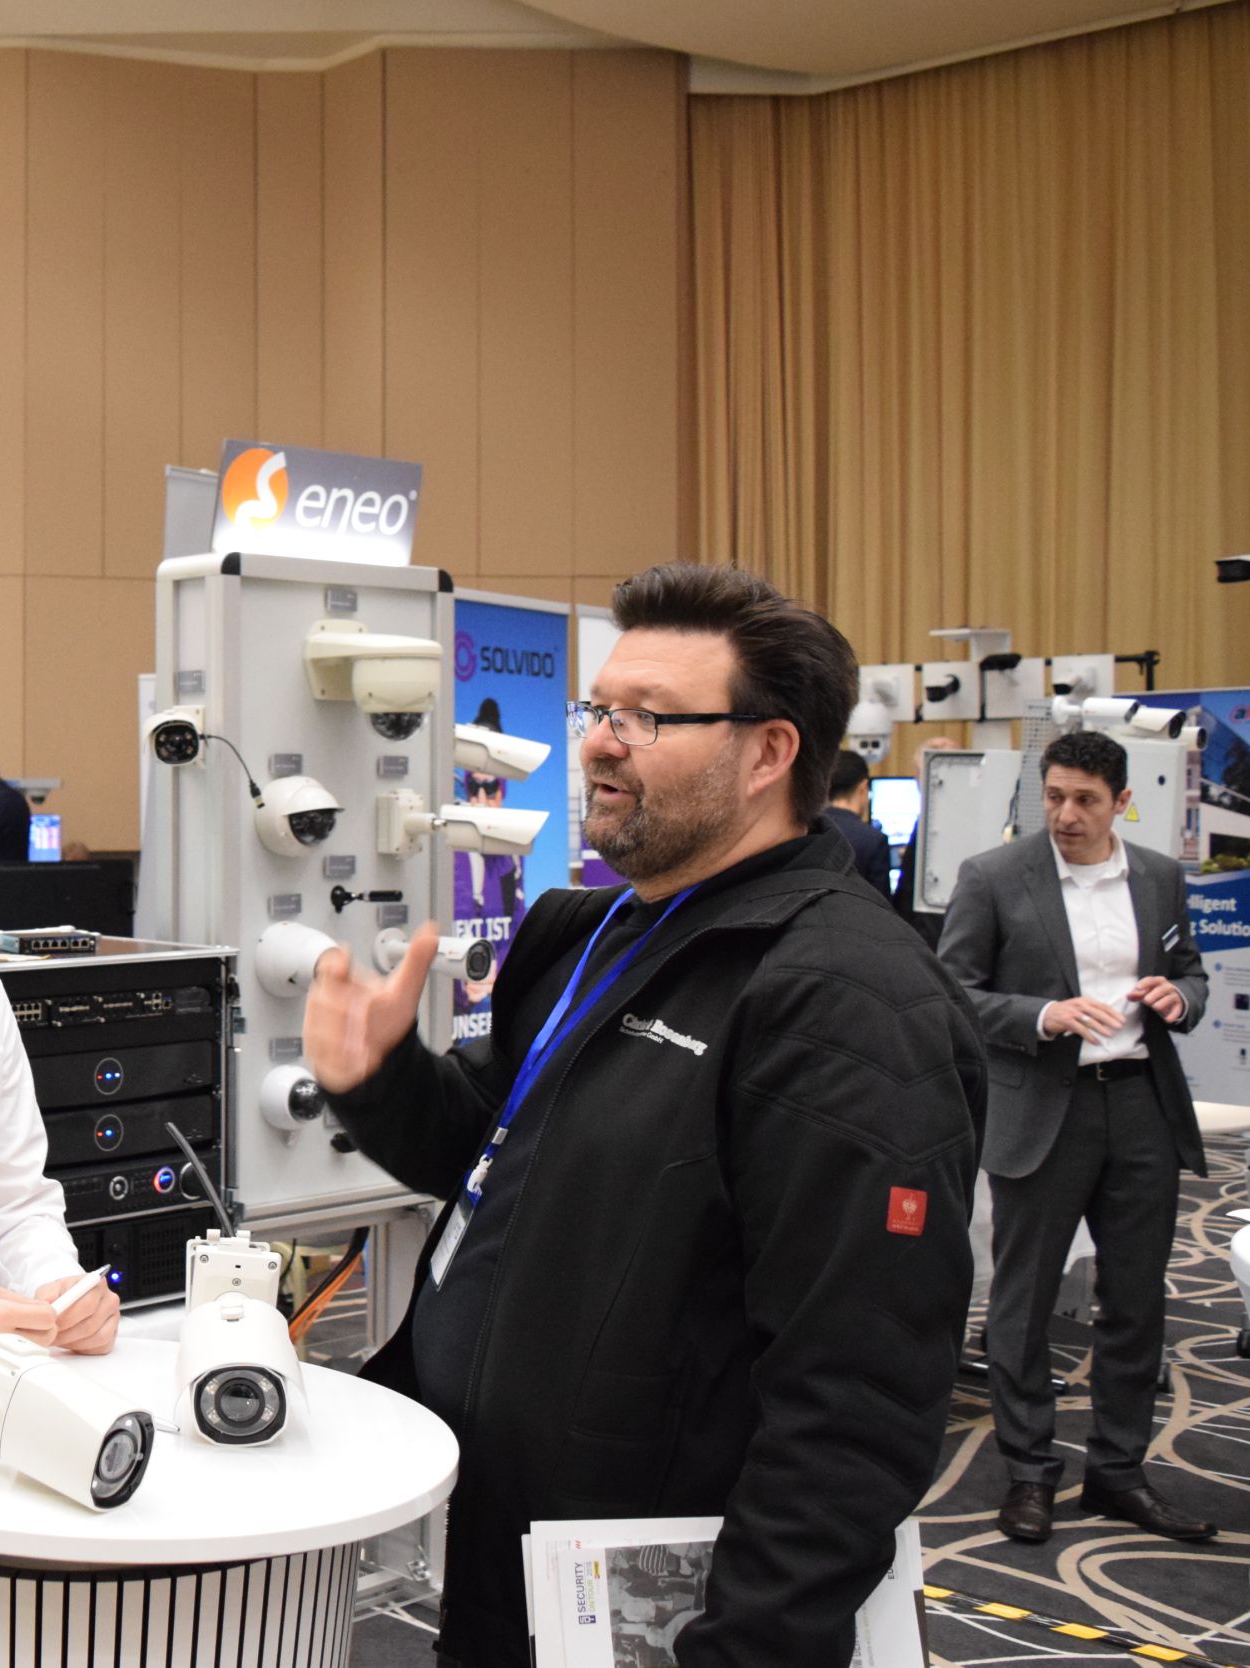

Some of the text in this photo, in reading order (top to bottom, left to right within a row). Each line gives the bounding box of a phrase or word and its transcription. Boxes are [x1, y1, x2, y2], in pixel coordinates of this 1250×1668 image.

[295, 484, 409, 536] eneo
[480, 646, 555, 678] SOLVIDO
[486, 916, 512, 941] IST
[575, 1562, 586, 1613] SECURITY
